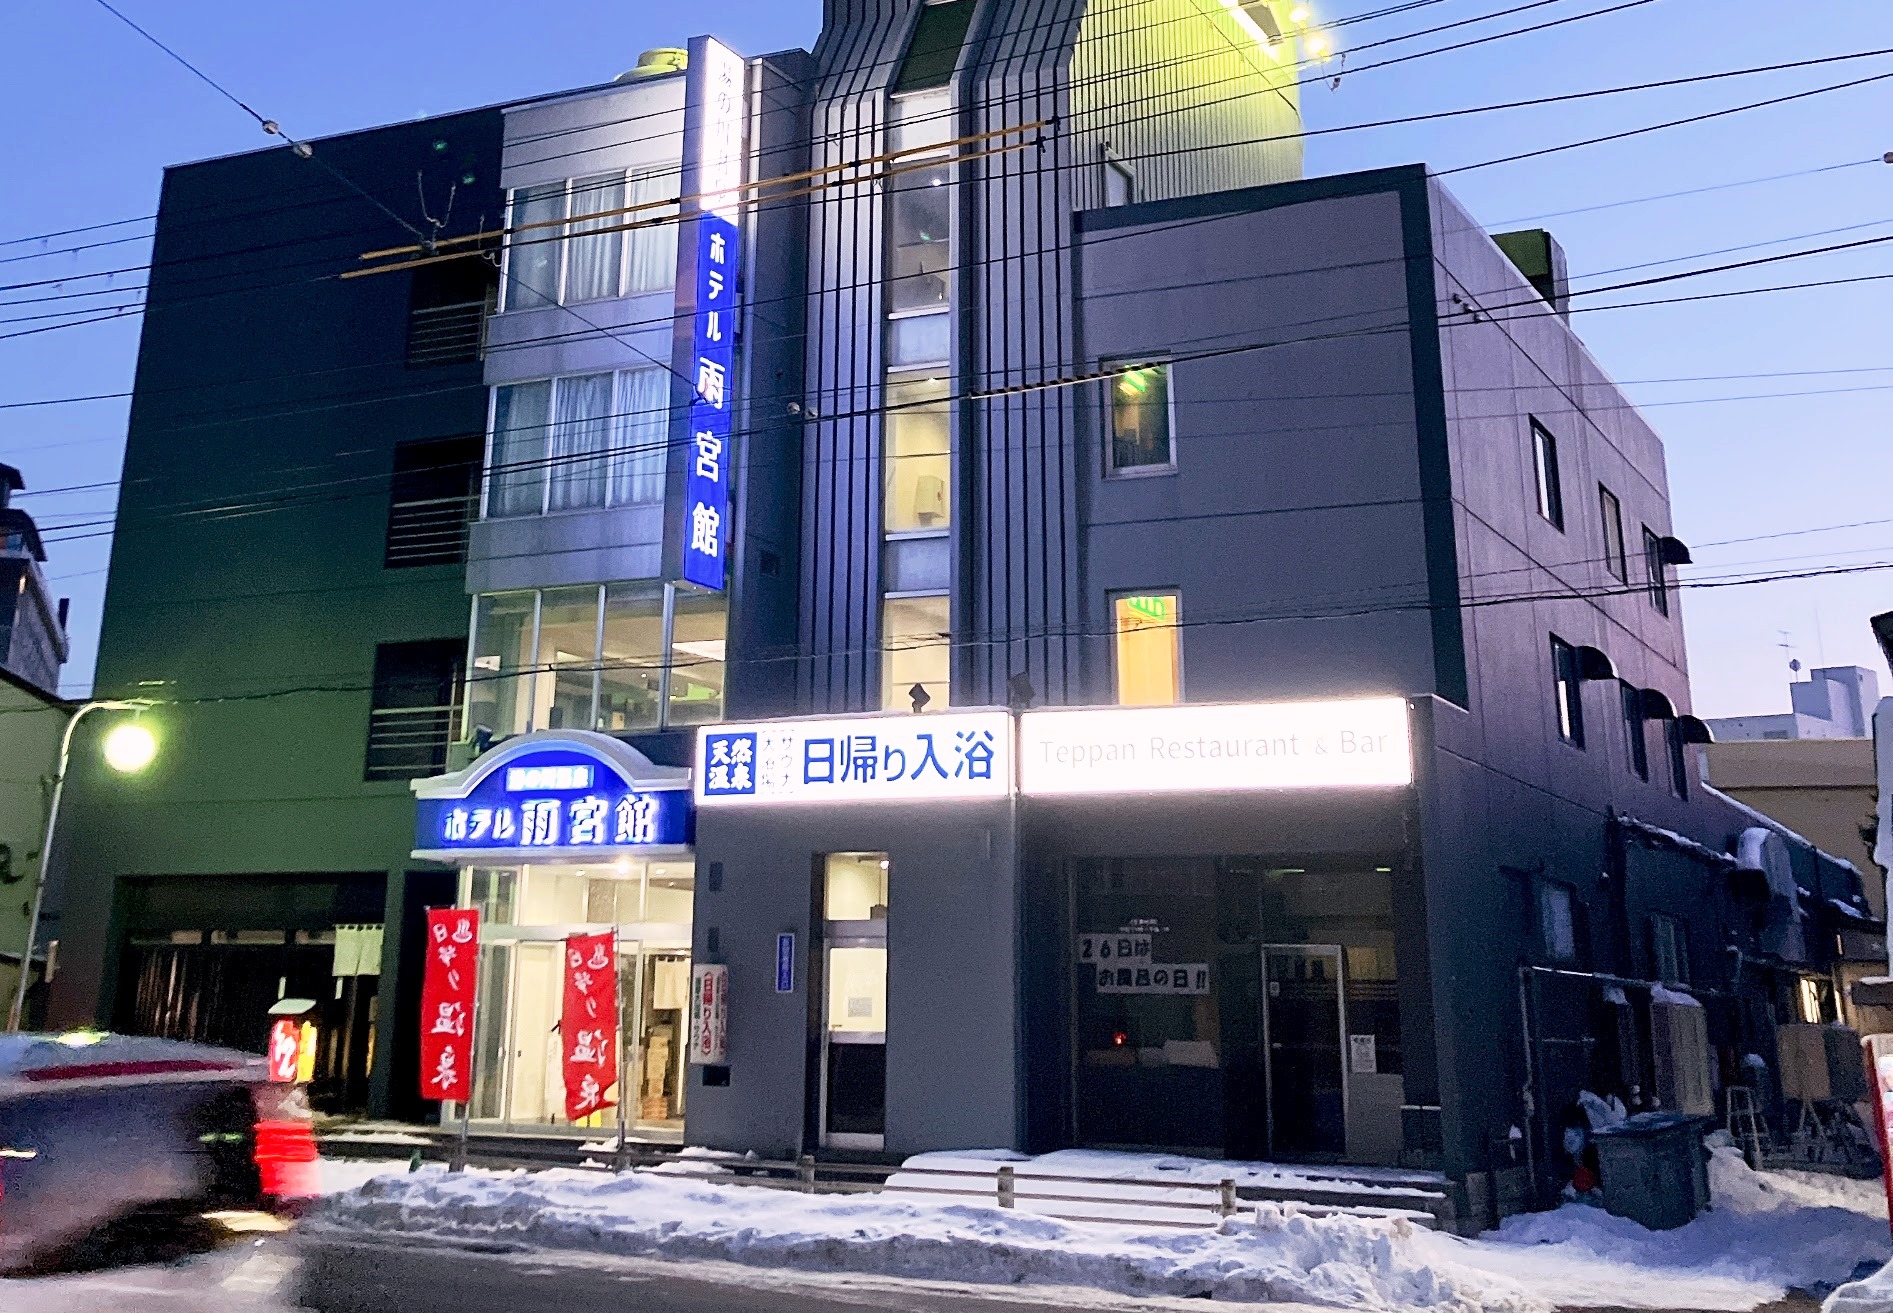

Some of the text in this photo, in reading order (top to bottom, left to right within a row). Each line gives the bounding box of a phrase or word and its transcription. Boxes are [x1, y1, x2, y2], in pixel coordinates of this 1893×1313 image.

[691, 231, 727, 558] ホテル雨宮館
[803, 729, 995, 785] 日帰り入浴
[1039, 729, 1389, 769] Teppan Restaurant & Bar
[444, 794, 658, 846] ホテル雨宮館
